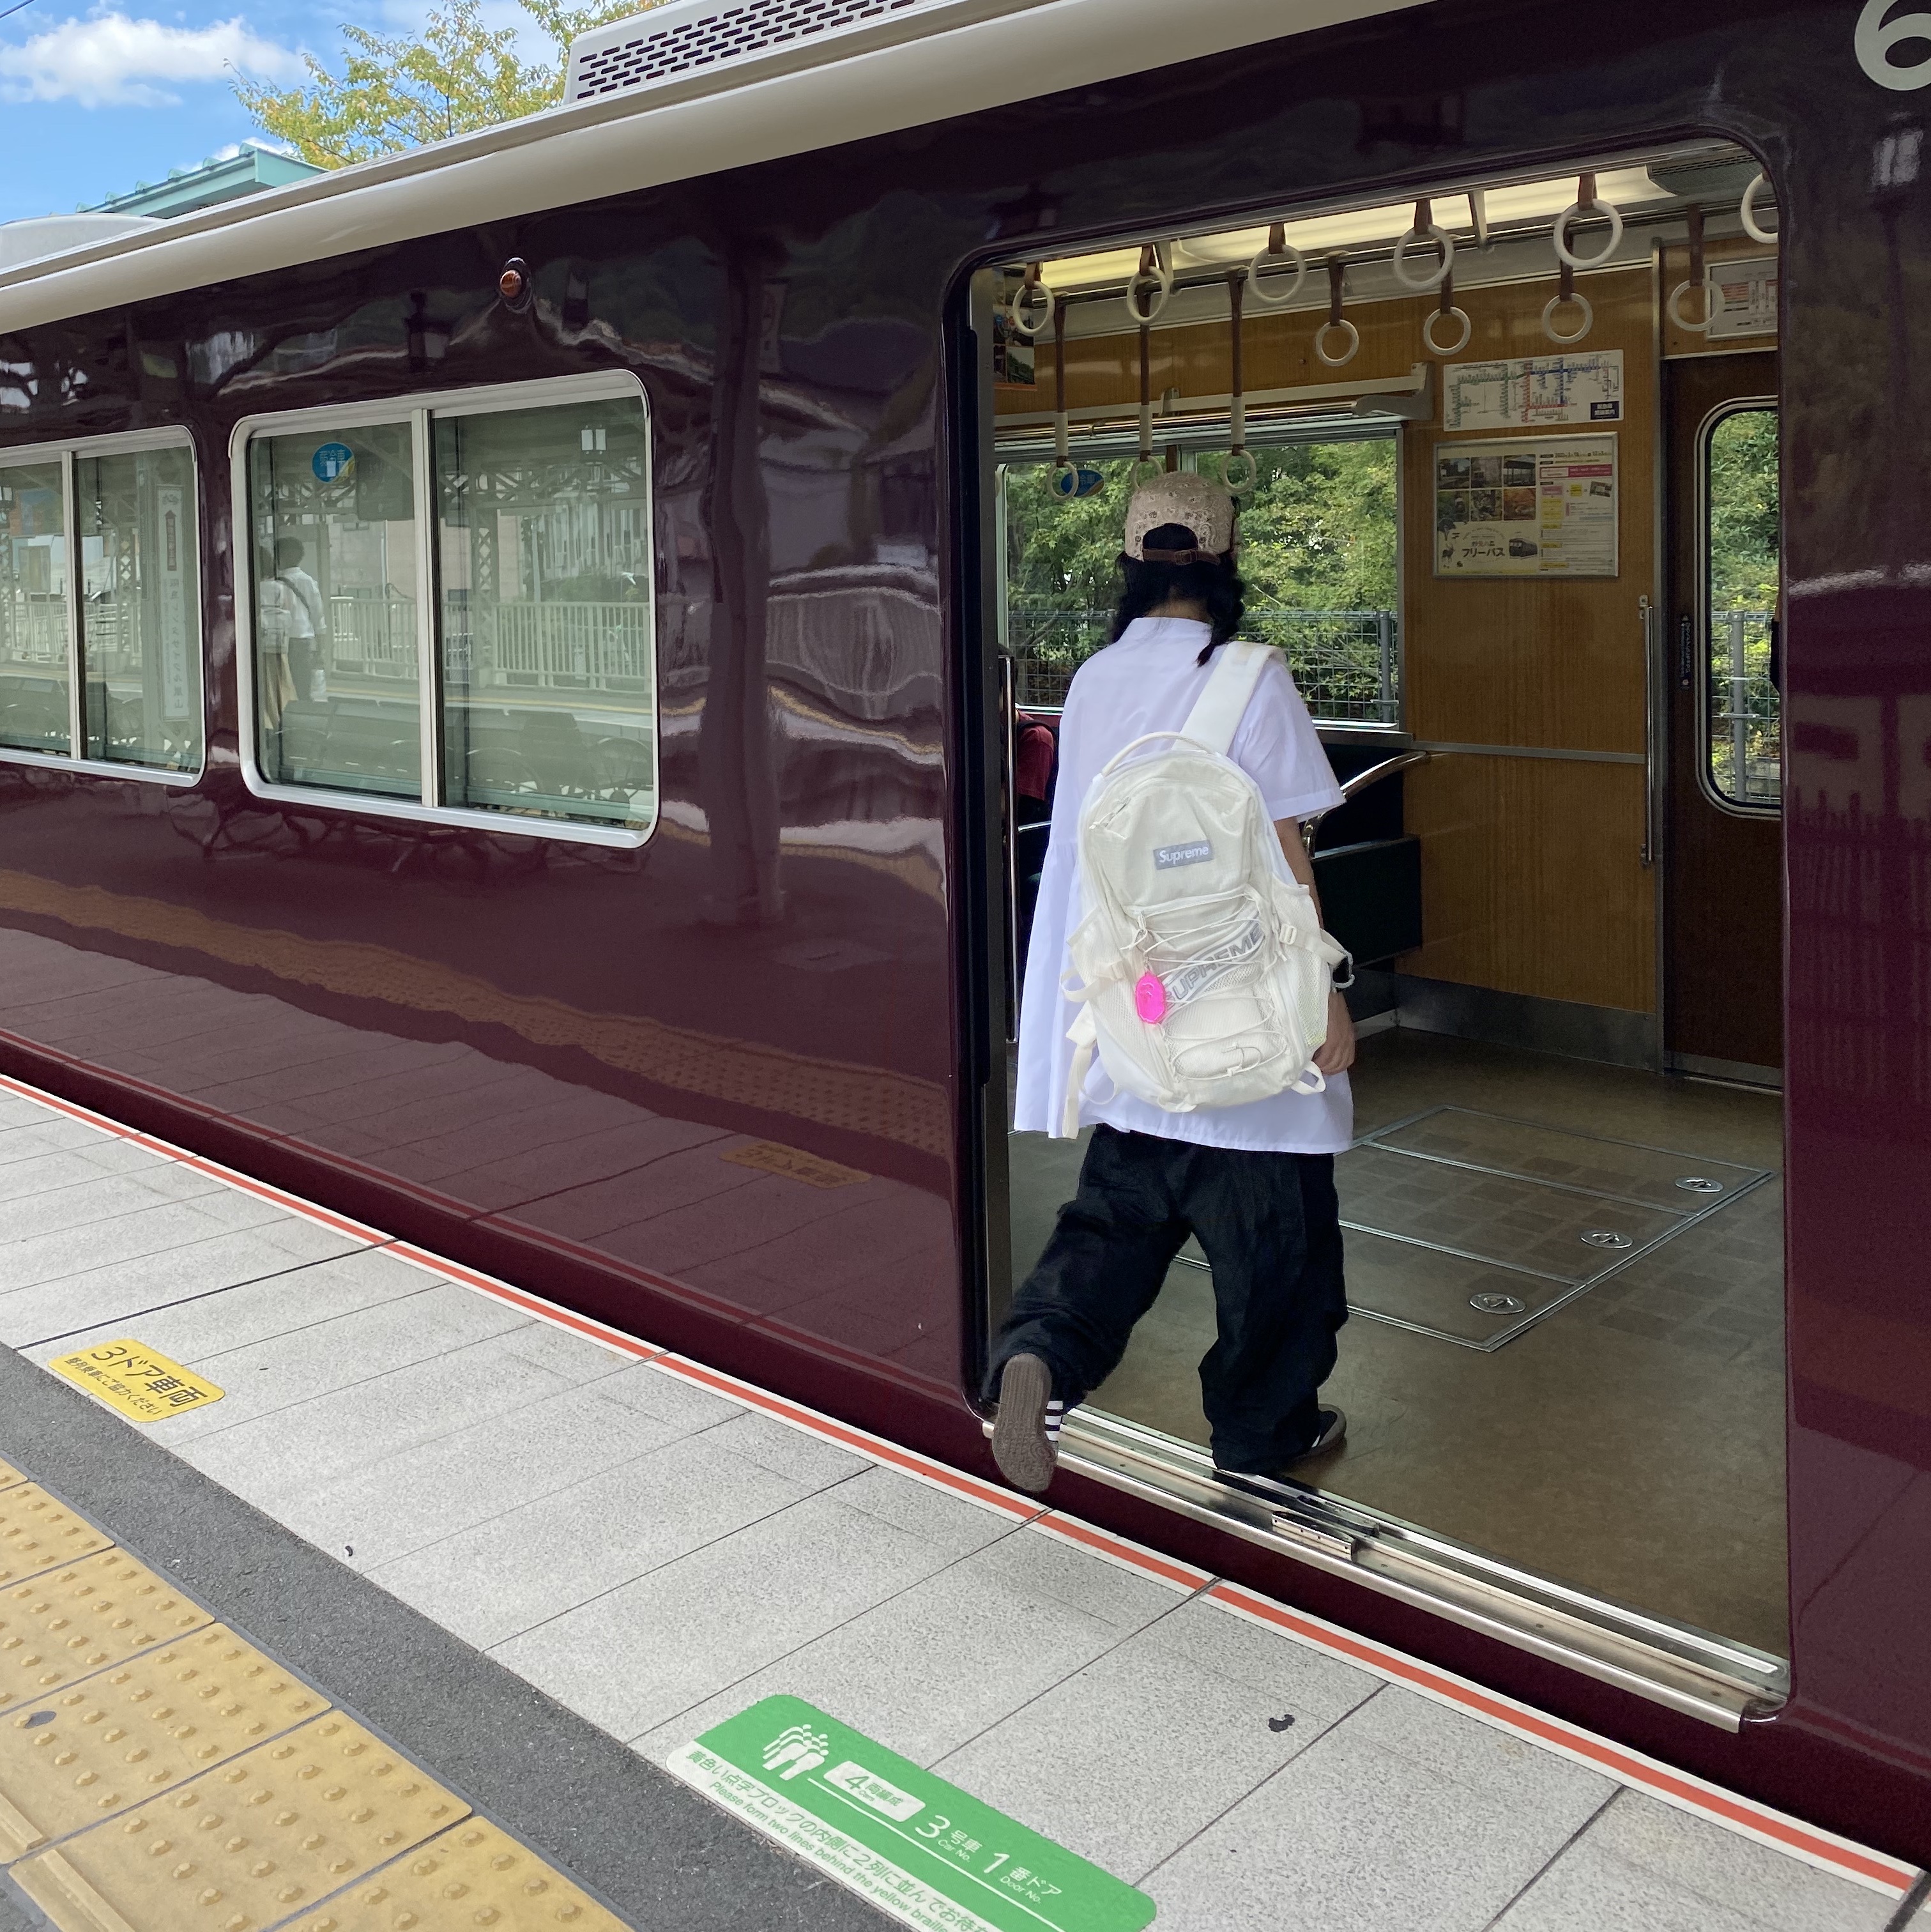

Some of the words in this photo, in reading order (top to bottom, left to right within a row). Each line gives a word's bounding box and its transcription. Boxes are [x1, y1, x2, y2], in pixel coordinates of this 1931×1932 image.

[1854, 0, 1931, 91] 6
[1158, 845, 1210, 864] Supreme
[64, 1357, 162, 1414] 整列乗車にご協力ください
[91, 1346, 208, 1407] 3ドア車両
[845, 1776, 869, 1790] 4
[865, 1782, 904, 1806] 両編成
[709, 1781, 744, 1805] Please
[743, 1803, 768, 1821] form
[767, 1819, 789, 1834] two
[788, 1831, 814, 1851] lines
[814, 1848, 853, 1874] behind
[853, 1871, 873, 1887] the
[873, 1885, 912, 1912] yellow
[915, 1814, 950, 1838] 3
[950, 1830, 982, 1853] 号車
[938, 1839, 954, 1852] Car
[955, 1849, 970, 1862] No.
[984, 1852, 1010, 1873] 1
[1009, 1866, 1062, 1895] 番ドア
[1000, 1876, 1025, 1893] Door
[1026, 1890, 1041, 1904] No.
